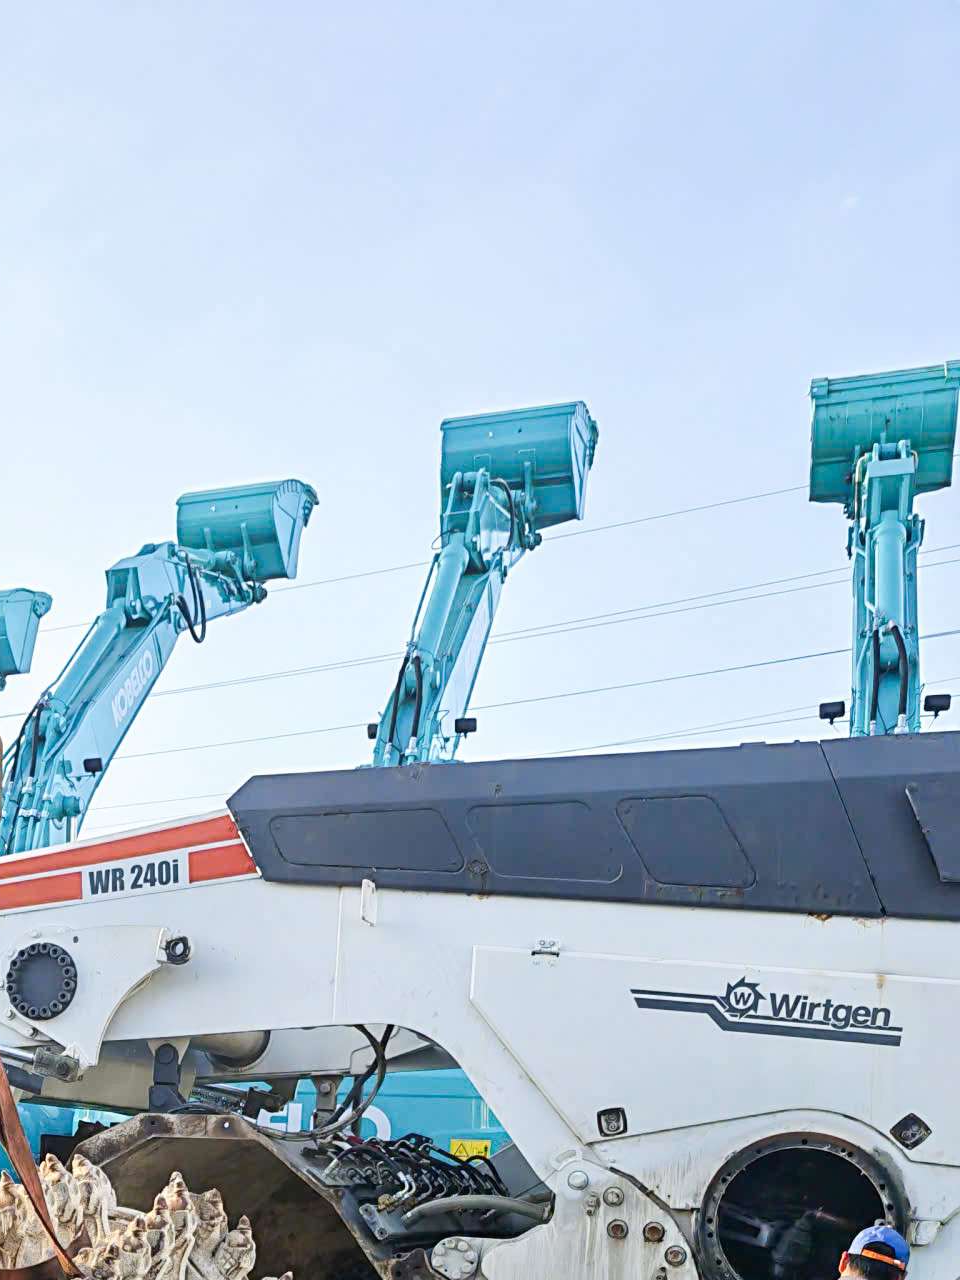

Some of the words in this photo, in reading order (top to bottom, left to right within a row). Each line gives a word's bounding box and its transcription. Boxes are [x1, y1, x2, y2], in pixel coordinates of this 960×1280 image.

[112, 649, 153, 728] KOBELCO
[88, 867, 125, 895] WR
[130, 859, 179, 890] 240i
[770, 992, 891, 1030] Wirtgen
